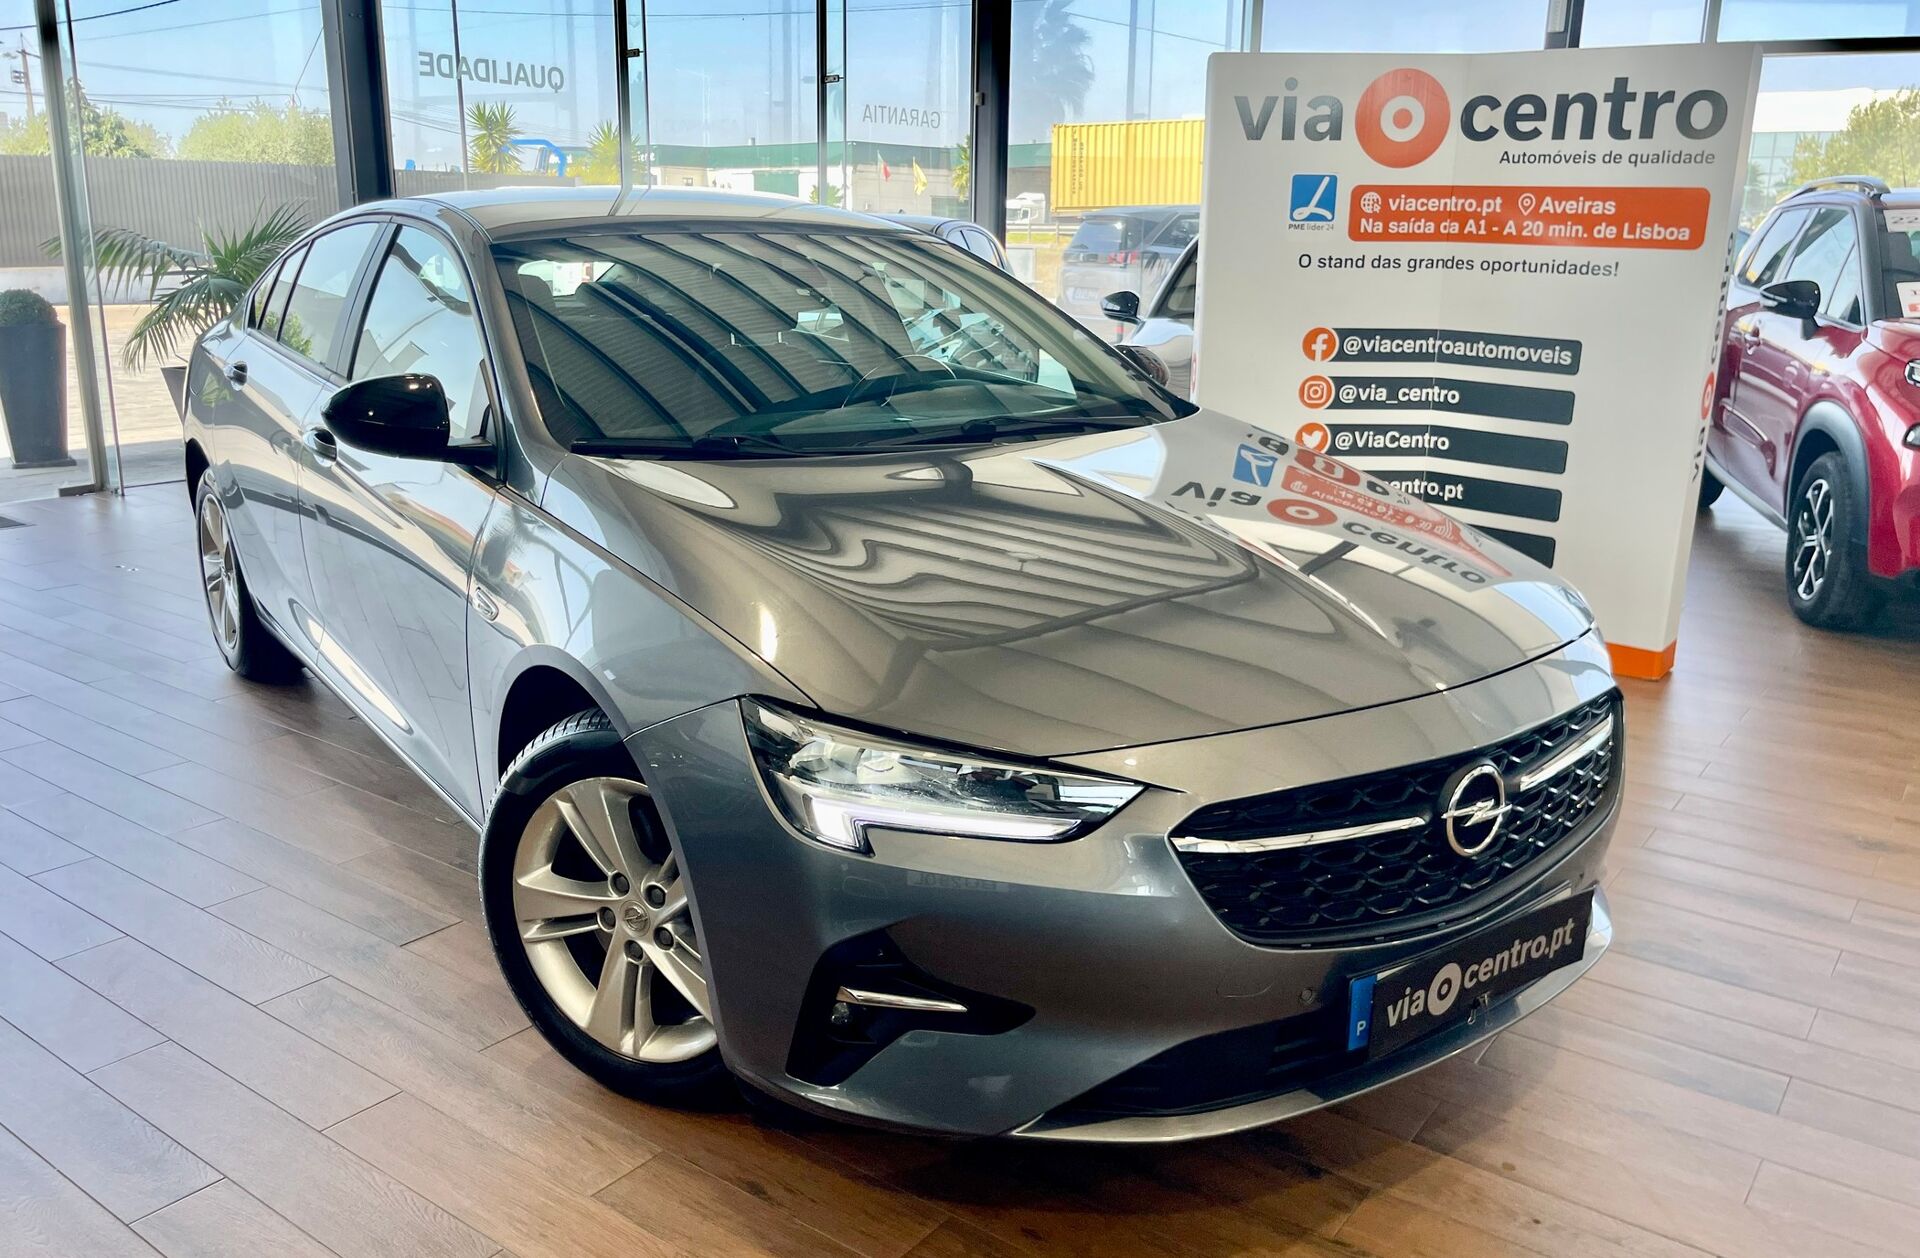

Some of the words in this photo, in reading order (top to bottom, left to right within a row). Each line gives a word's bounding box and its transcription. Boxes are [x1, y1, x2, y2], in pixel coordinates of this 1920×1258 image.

[1234, 77, 1344, 142] via
[1460, 76, 1729, 142] centro
[1499, 150, 1597, 165] Automóveis
[1602, 150, 1623, 165] de
[1628, 150, 1716, 168] qualidade
[1388, 194, 1503, 217] viacentro.pt
[1539, 196, 1616, 215] Aveiras
[1288, 223, 1305, 231] PME
[1360, 218, 1384, 234] Na
[1388, 217, 1436, 235] saída
[1440, 219, 1460, 235] da
[1464, 219, 1488, 236] A1
[1503, 220, 1518, 237] A
[1522, 221, 1544, 238] 20
[1549, 221, 1588, 239] min.
[1593, 222, 1618, 239] de
[1623, 223, 1691, 241] Lisboa
[1298, 253, 1312, 269] O
[1317, 254, 1366, 269] stand
[1371, 254, 1402, 269] das
[1407, 255, 1475, 273] grandes
[1480, 257, 1620, 277] oportunidades!
[1343, 335, 1573, 366] @viacentroautomoveis
[1338, 384, 1460, 404] @via_centro
[1335, 431, 1450, 450] @ViaCentro
[1387, 985, 1427, 1028] via
[1463, 918, 1575, 990] centro.pt
[1356, 1020, 1367, 1037] P
